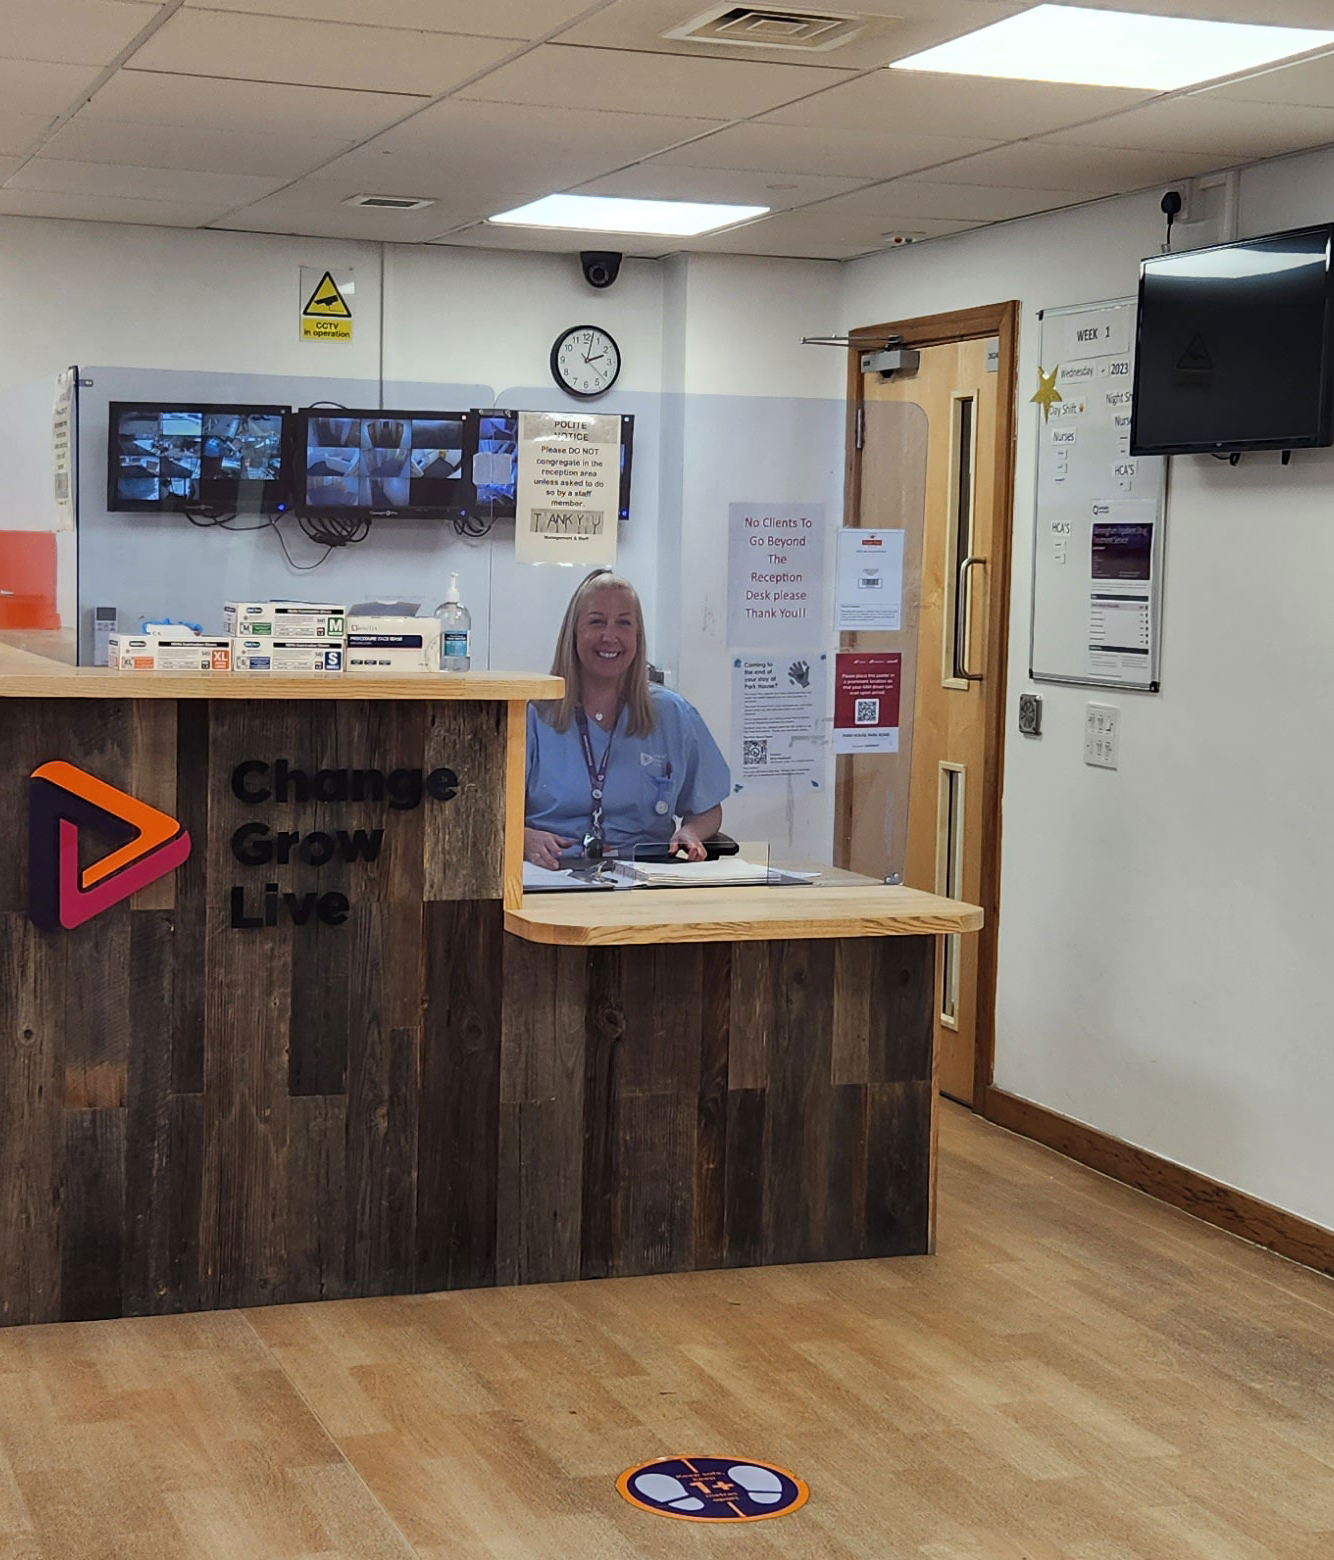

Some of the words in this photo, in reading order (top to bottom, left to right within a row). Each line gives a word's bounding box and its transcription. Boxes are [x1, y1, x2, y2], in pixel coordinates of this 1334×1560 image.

[313, 329, 350, 338] operation
[583, 333, 591, 341] 12
[1077, 328, 1098, 342] WEEK
[1105, 326, 1110, 338] 1
[565, 344, 572, 352] 10
[564, 368, 568, 376] 8
[1061, 366, 1093, 378] Wednesday
[1111, 363, 1128, 375] 2023
[1106, 392, 1123, 405] Night
[1063, 403, 1077, 414] Shift
[555, 421, 587, 429] POLITE
[1115, 416, 1131, 426] Nurs
[1053, 432, 1074, 441] Nurses
[541, 446, 566, 454] Please
[537, 459, 580, 467] congregate
[542, 469, 578, 477] reception
[1115, 465, 1134, 475] HCA'S
[557, 489, 566, 498] by
[745, 518, 759, 528] No
[763, 518, 797, 528] Clients
[801, 518, 812, 528] To
[1052, 522, 1069, 534] HCA'S
[749, 536, 764, 546] Go
[767, 536, 805, 547] Beyond
[768, 554, 787, 564] The
[751, 572, 802, 584] Reception
[746, 590, 770, 600] Desk
[774, 590, 806, 602] please
[745, 608, 776, 618] Thank
[330, 619, 342, 631] M
[214, 652, 228, 660] XL
[329, 653, 338, 664] S
[232, 759, 458, 810] Change
[232, 823, 384, 866] Grow
[231, 883, 349, 928] Live
